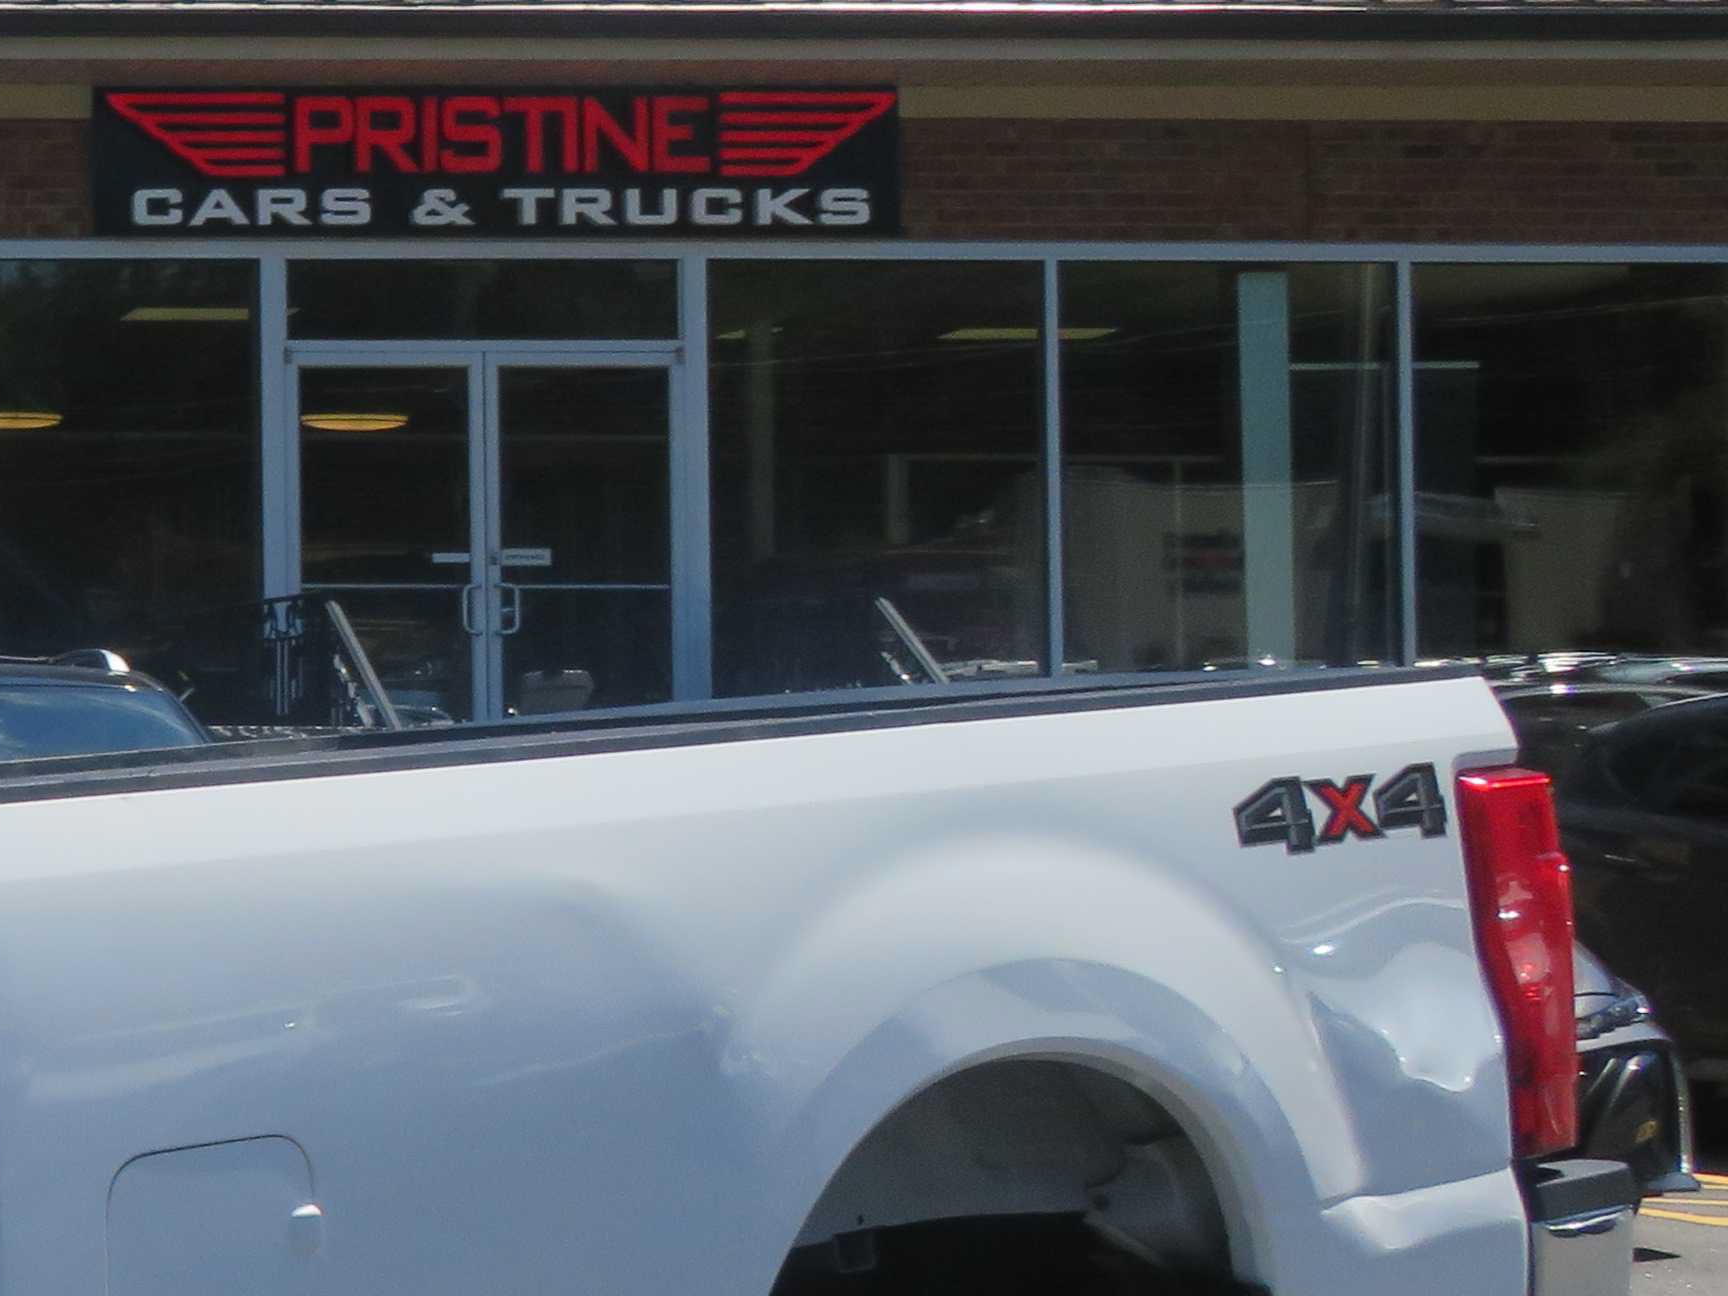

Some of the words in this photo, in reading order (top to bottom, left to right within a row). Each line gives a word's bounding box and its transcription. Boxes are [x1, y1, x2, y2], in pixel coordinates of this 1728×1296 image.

[296, 95, 710, 173] PRISTINE
[132, 188, 373, 226] CARS
[412, 188, 476, 226] &
[501, 187, 872, 226] TRUCKS
